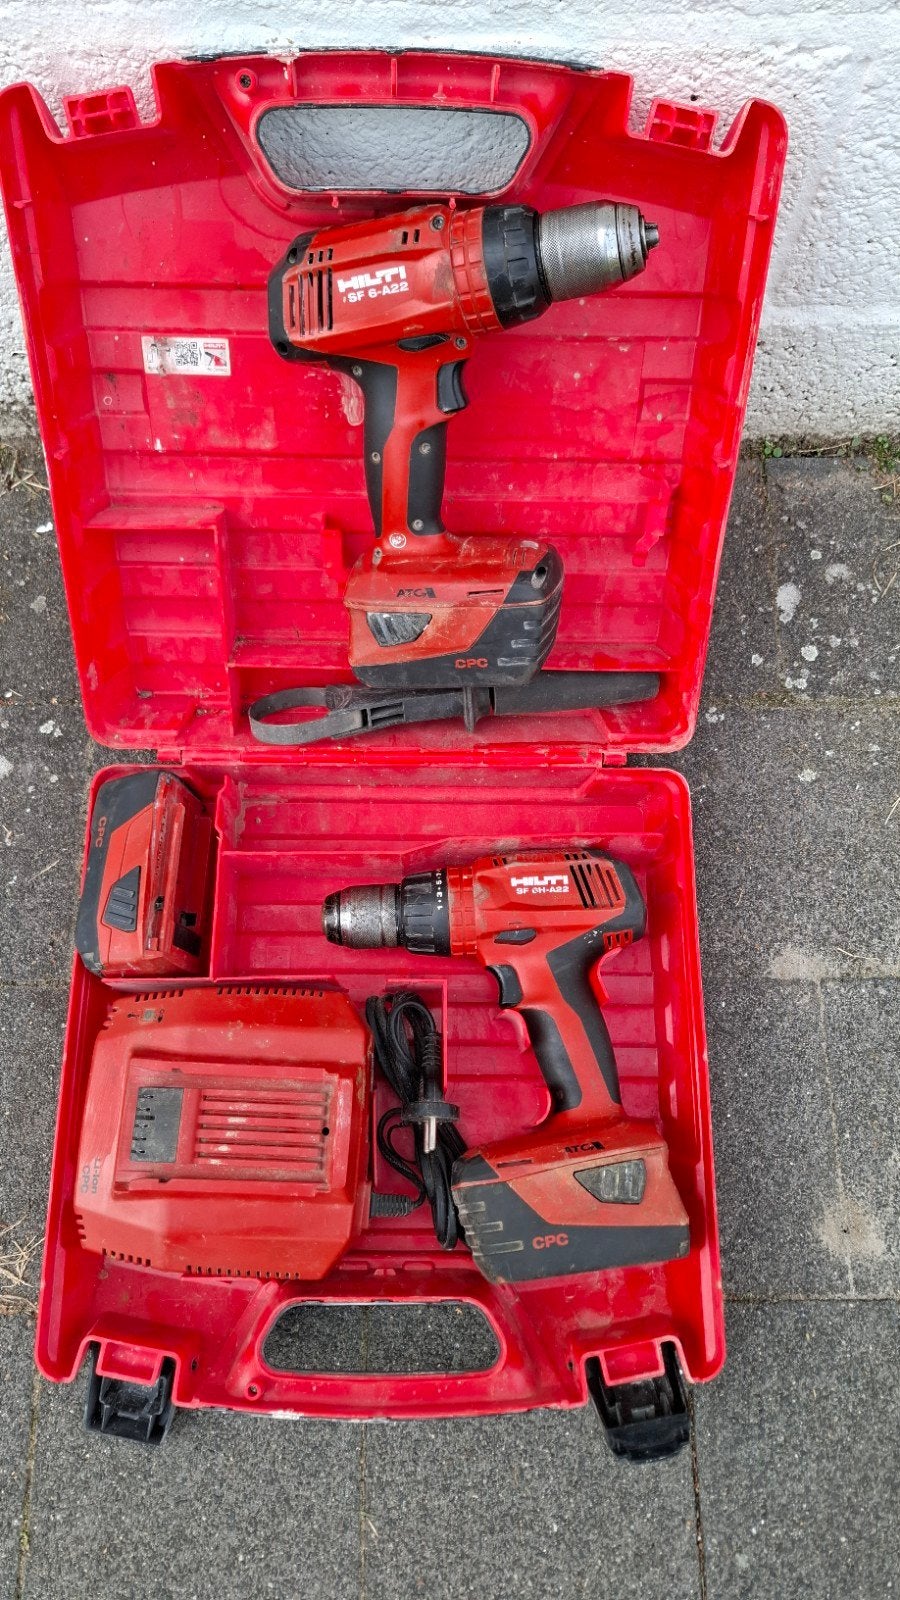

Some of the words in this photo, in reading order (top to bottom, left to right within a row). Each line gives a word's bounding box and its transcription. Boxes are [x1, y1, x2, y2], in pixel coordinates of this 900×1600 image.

[336, 265, 407, 293] HILTI
[347, 290, 365, 303] SF
[367, 281, 409, 299] 6-A22
[455, 657, 489, 669] CPC
[95, 816, 107, 848] CPC
[510, 874, 569, 887] HILTI
[516, 887, 529, 895] SF
[80, 1164, 91, 1194] CPC
[531, 1233, 569, 1250] CPC
